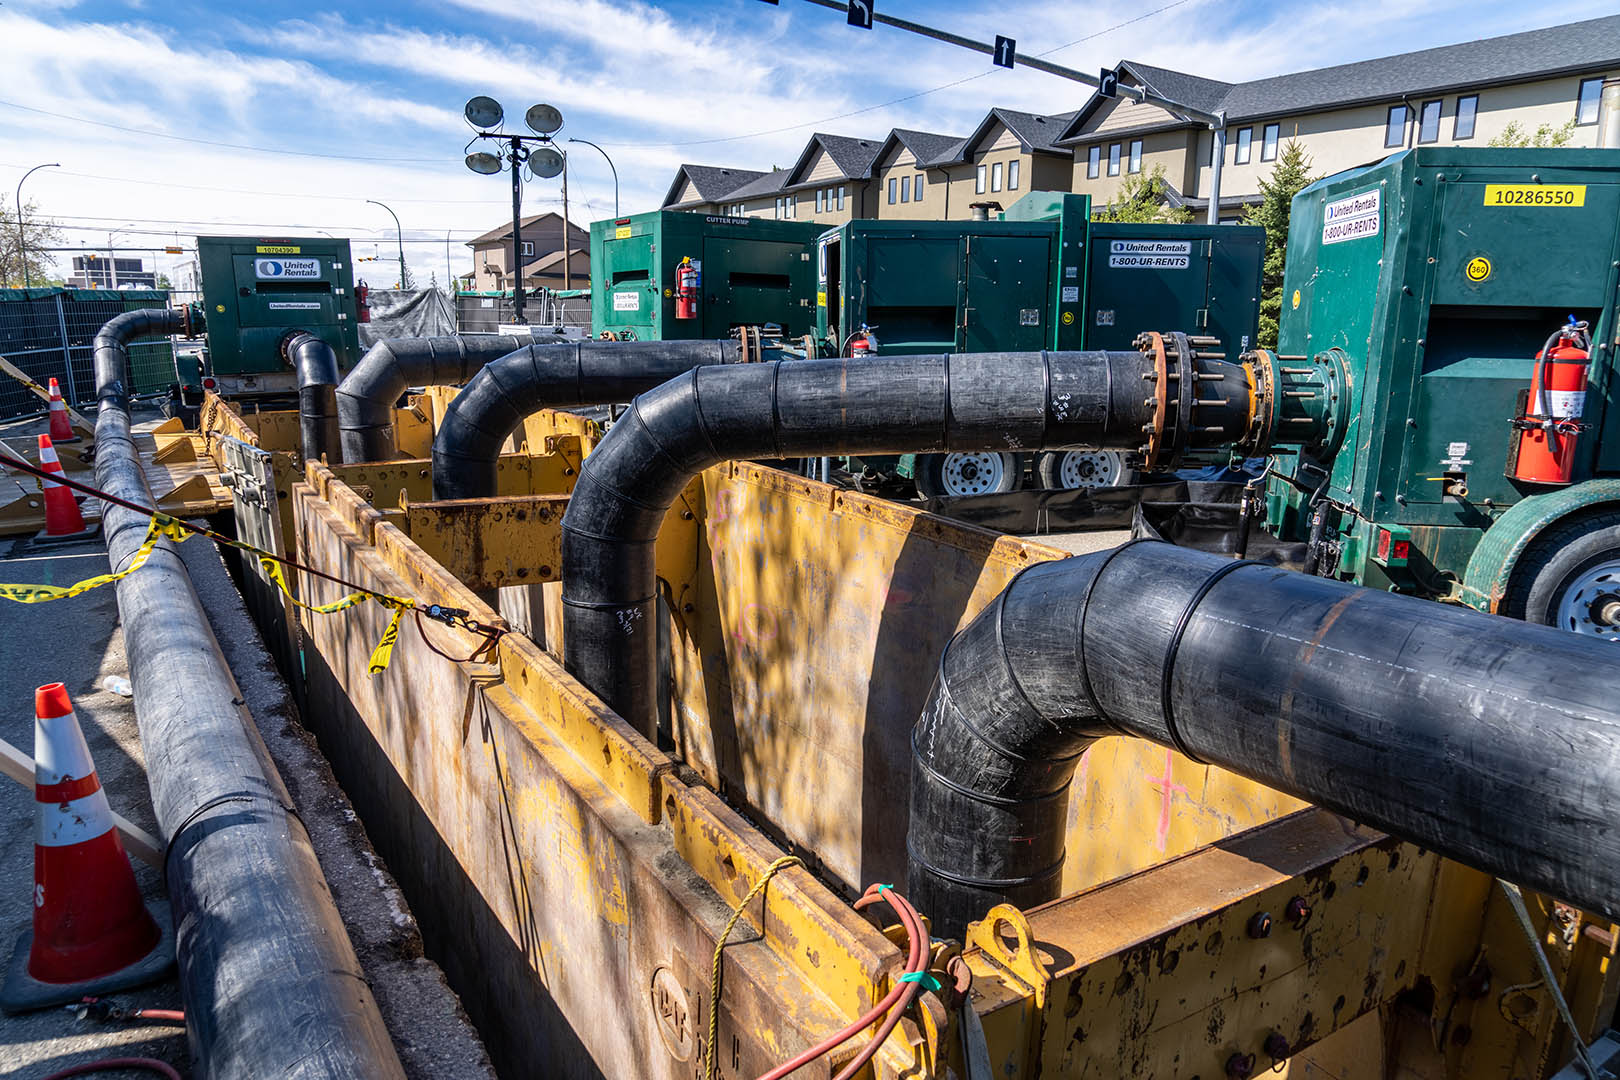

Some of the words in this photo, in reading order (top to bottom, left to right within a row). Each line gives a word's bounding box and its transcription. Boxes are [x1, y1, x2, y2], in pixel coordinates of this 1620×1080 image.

[1495, 190, 1575, 205] 10286550
[1333, 201, 1354, 218] United
[1354, 195, 1377, 213] Rentals
[1324, 216, 1378, 240] 1-800-UR-RENTS
[1126, 243, 1155, 252] United
[1156, 243, 1188, 252] Rentals
[284, 261, 315, 269] United
[1111, 257, 1187, 266] 1-800-UR-RENTS
[1471, 266, 1486, 274] 360
